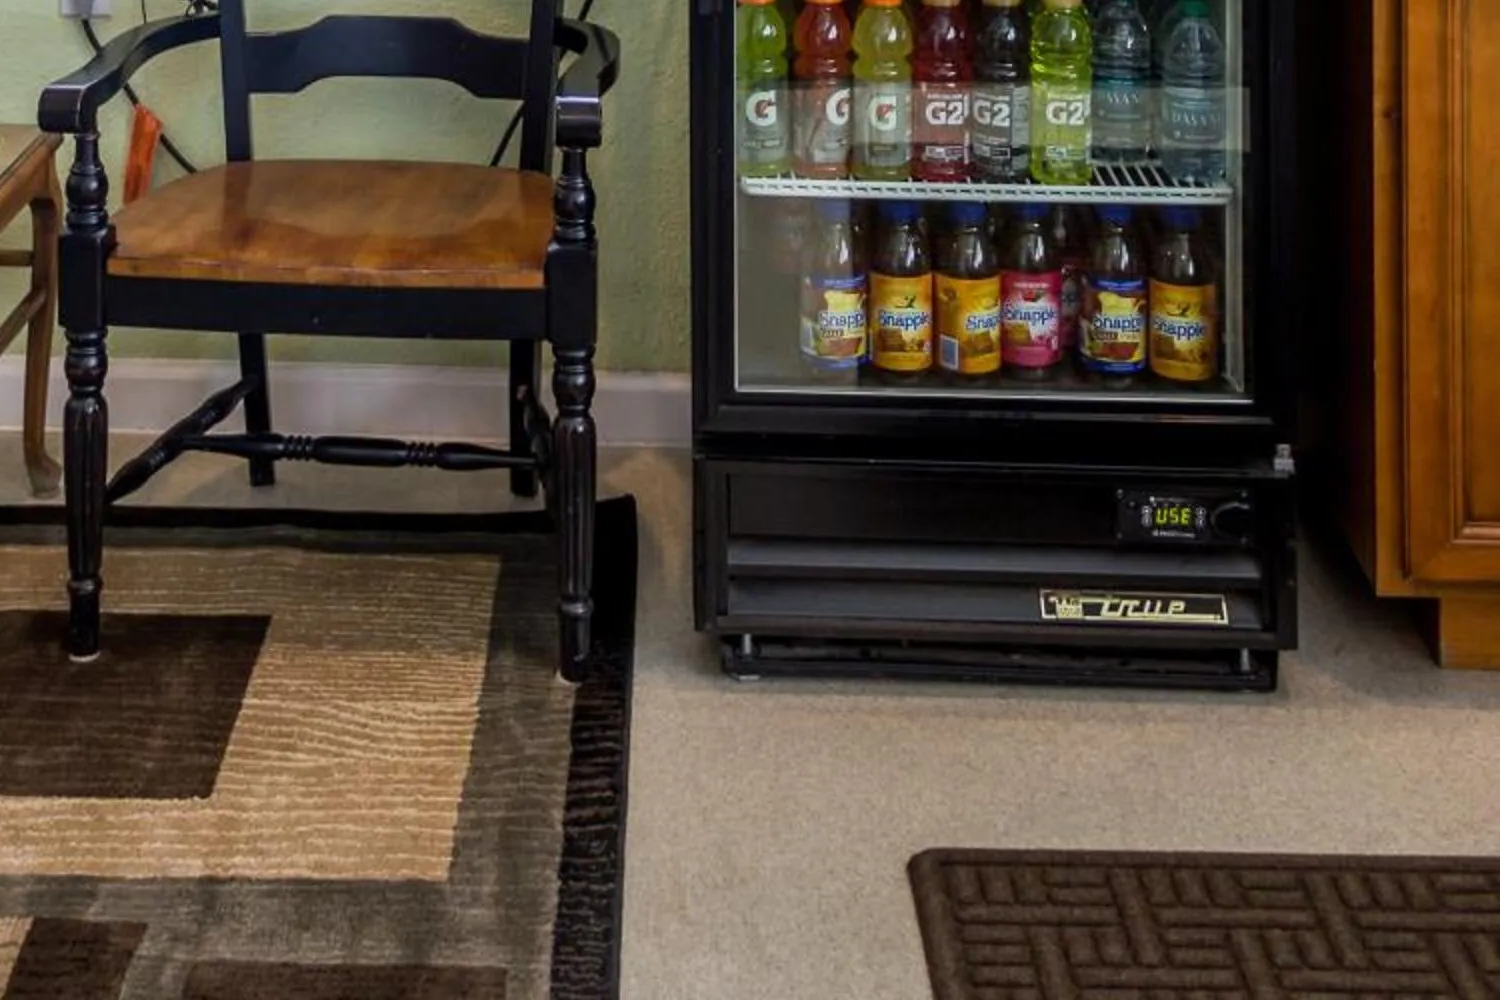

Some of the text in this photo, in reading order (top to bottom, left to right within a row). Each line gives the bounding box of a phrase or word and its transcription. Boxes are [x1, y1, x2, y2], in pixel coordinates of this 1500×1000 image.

[745, 89, 777, 127] G
[870, 96, 897, 132] G
[925, 101, 965, 126] G2
[973, 101, 1011, 128] G2
[1045, 101, 1085, 126] G2
[1155, 507, 1191, 525] USE
